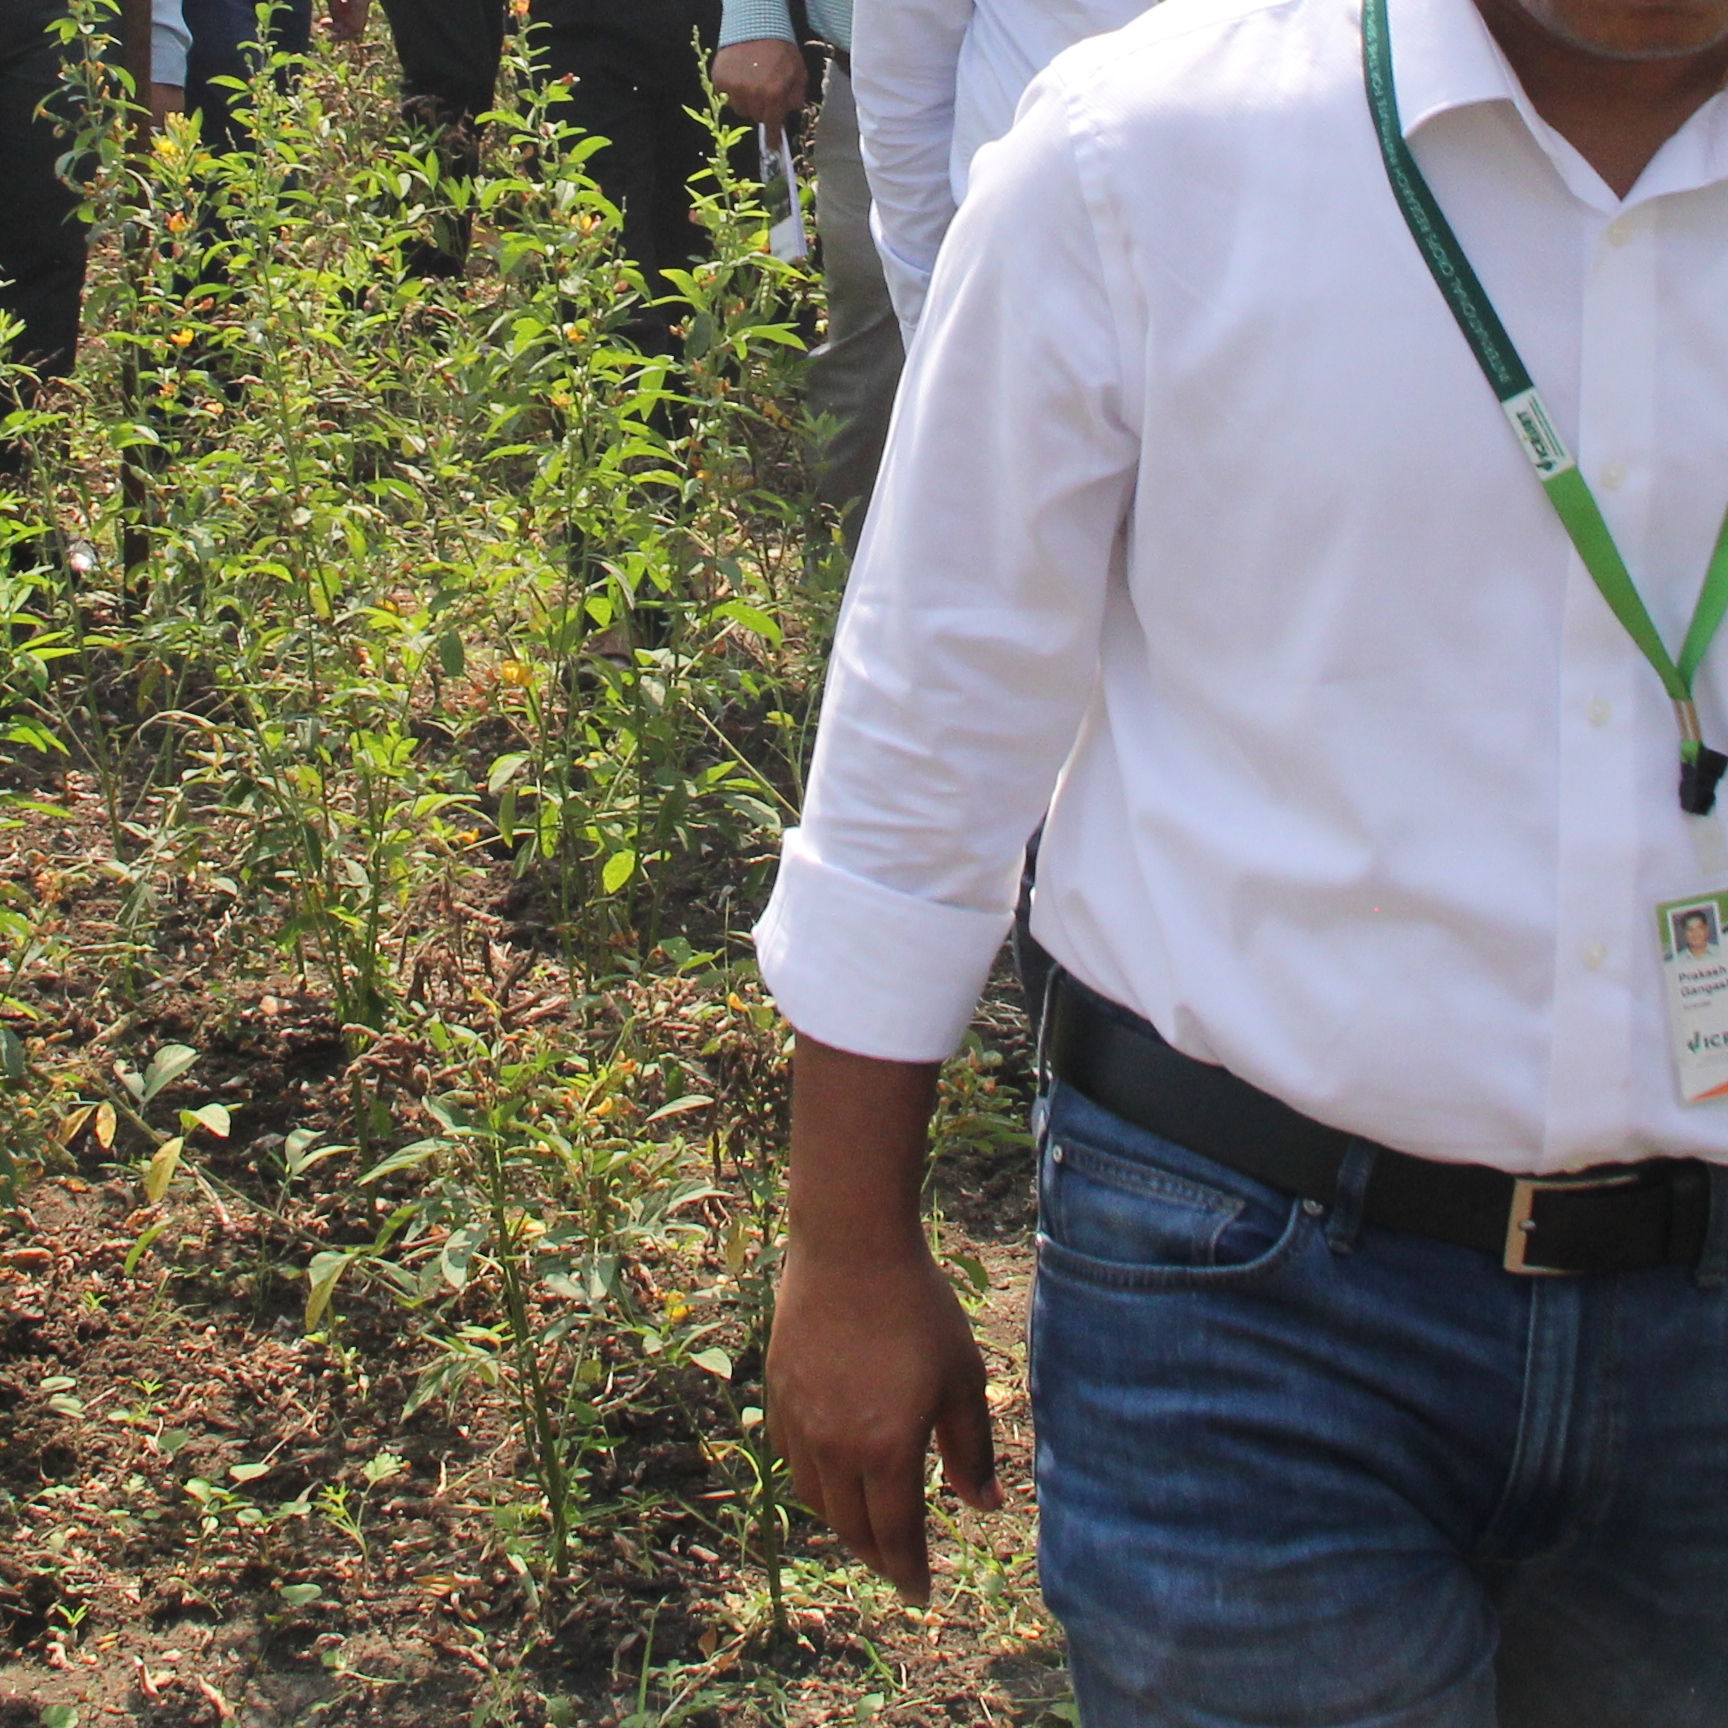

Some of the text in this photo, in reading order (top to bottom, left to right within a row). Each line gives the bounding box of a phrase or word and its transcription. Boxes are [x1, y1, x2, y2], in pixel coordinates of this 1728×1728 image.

[1424, 232, 1456, 278] CROPS
[1451, 276, 1512, 384] INTERNATIONAL
[1678, 965, 1728, 982] Prakash
